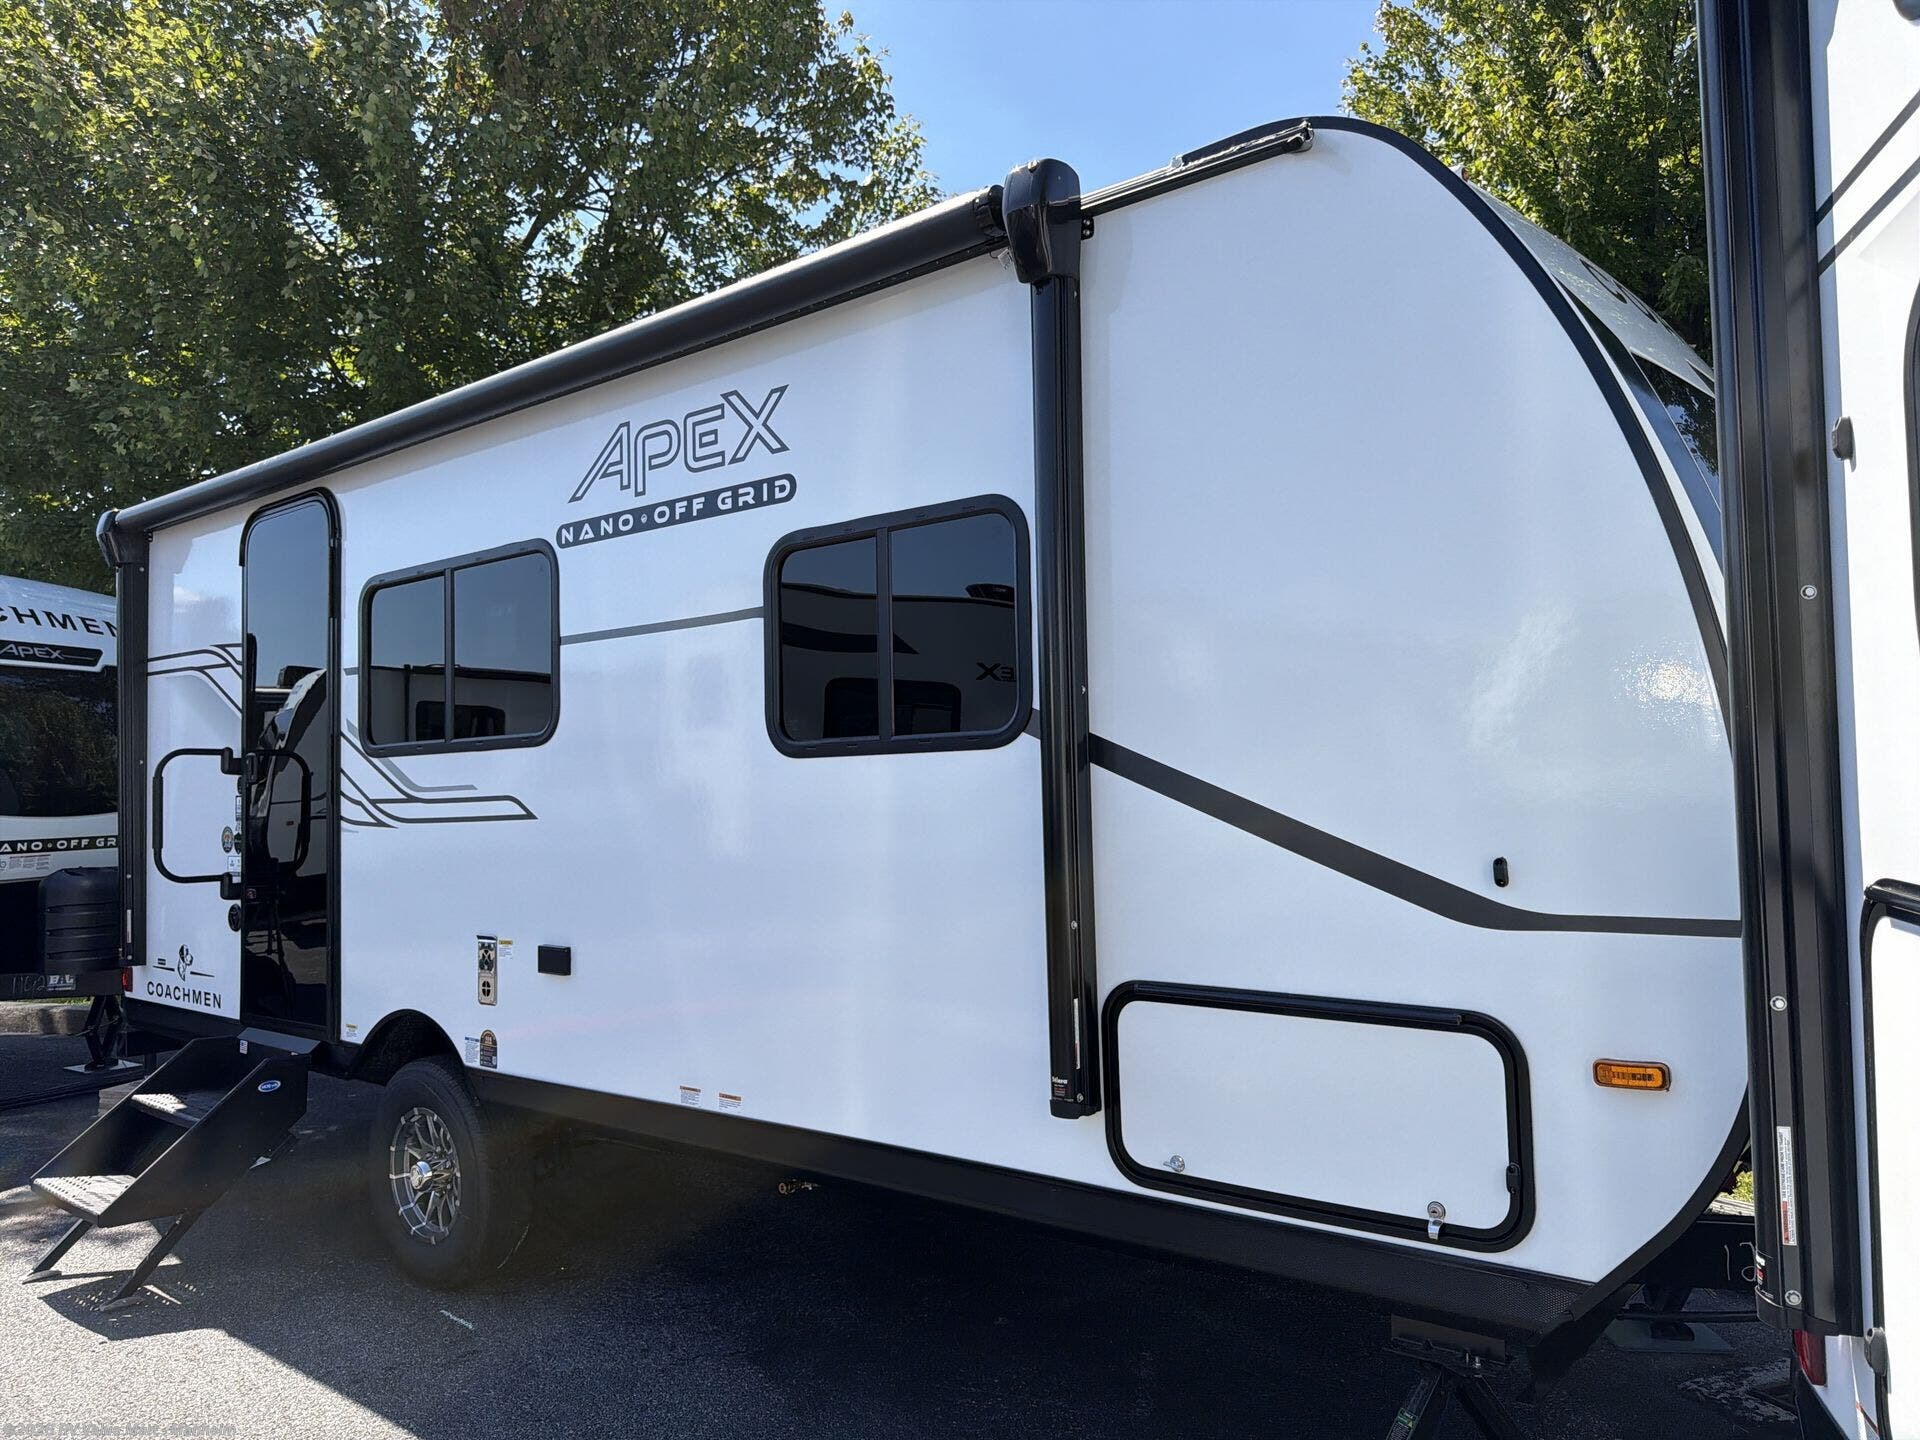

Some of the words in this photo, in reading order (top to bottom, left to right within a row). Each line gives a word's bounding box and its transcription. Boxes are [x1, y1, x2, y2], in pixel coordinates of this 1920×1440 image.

[568, 384, 790, 503] APEX
[561, 514, 634, 545] NANO
[653, 497, 705, 523] OFF
[717, 479, 791, 511] GRID
[0, 643, 64, 660] APEX
[56, 839, 90, 850] OFF
[147, 981, 222, 1009] COACHMEN
